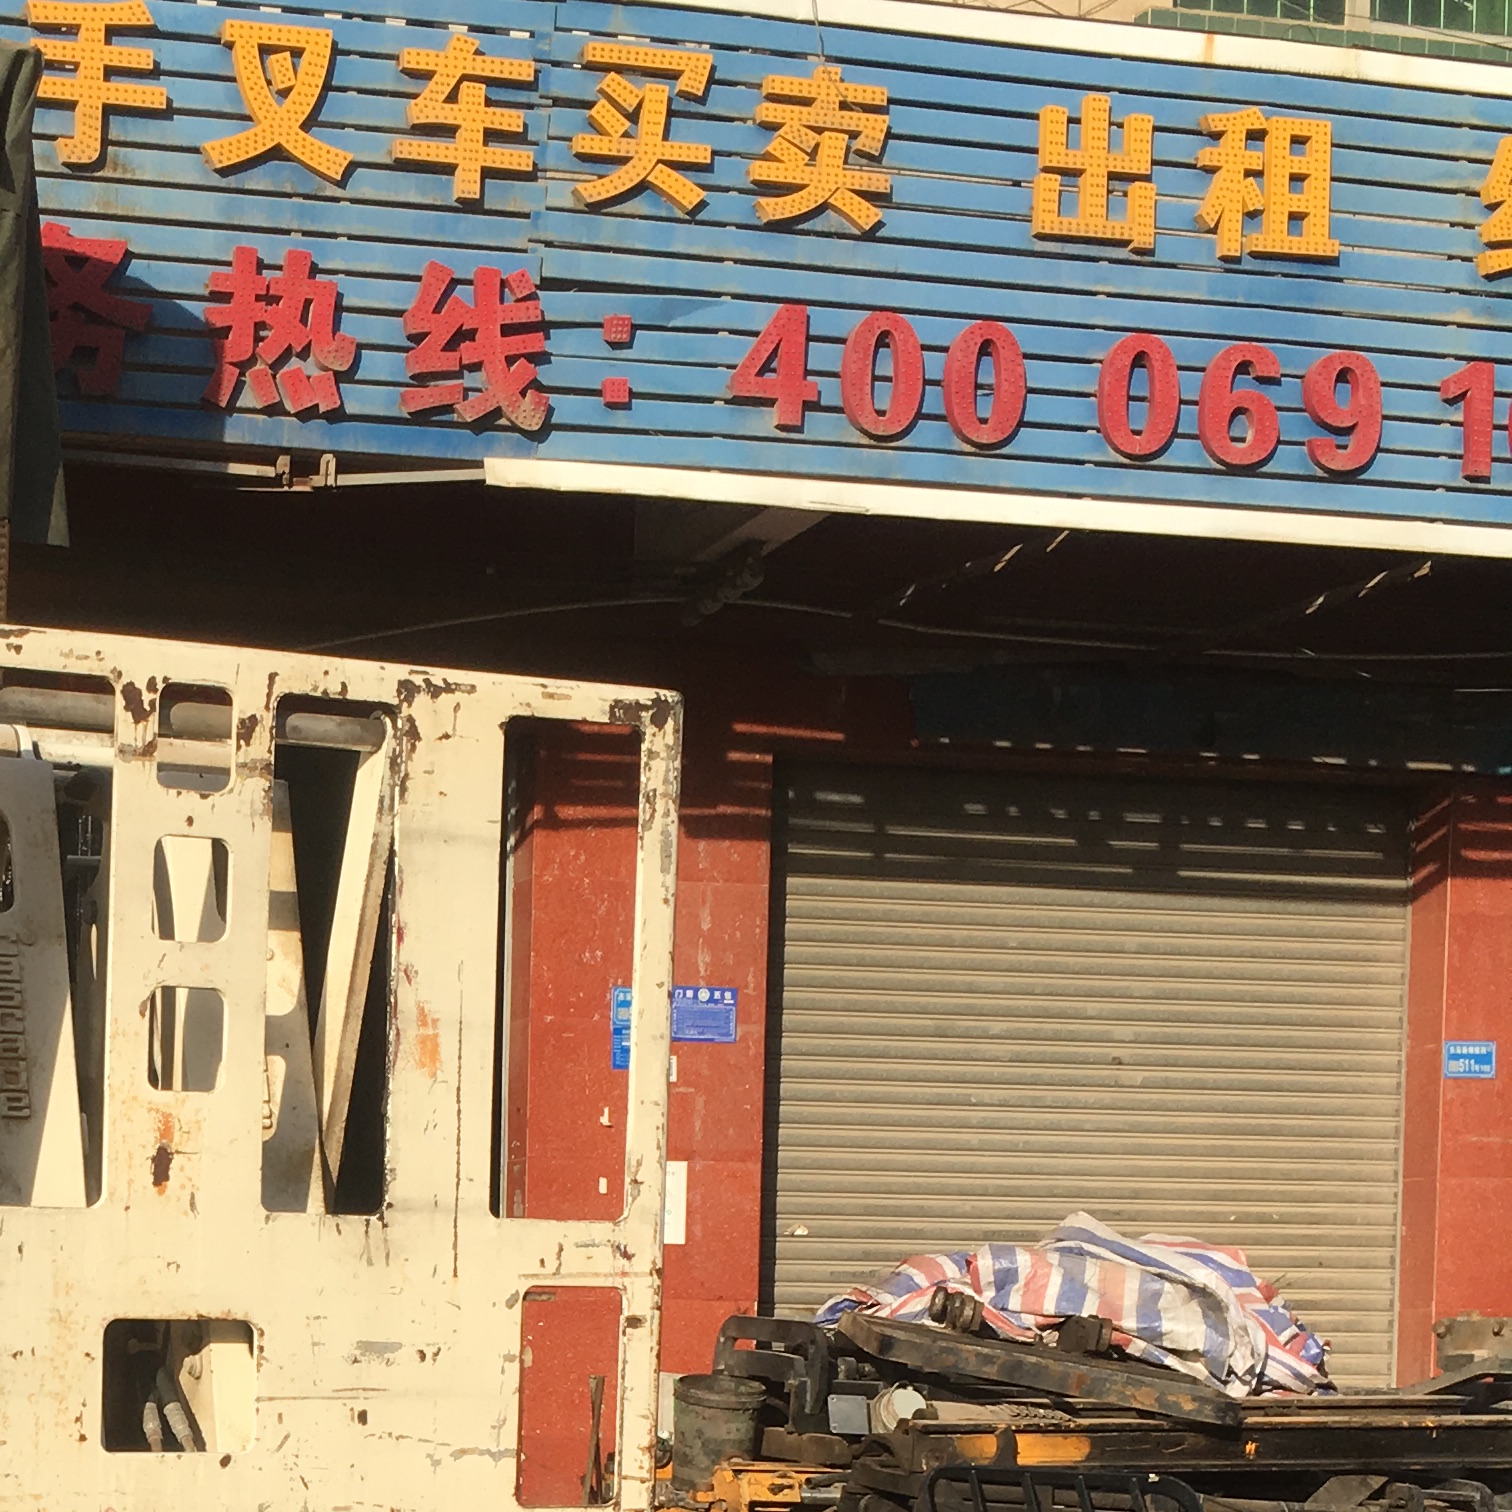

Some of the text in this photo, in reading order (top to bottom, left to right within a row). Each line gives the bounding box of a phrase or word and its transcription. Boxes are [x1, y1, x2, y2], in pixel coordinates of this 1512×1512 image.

[1031, 93, 1341, 262] 出租
[730, 303, 1027, 448] 400
[1097, 333, 1383, 474] 069
[1439, 361, 1512, 483] 1
